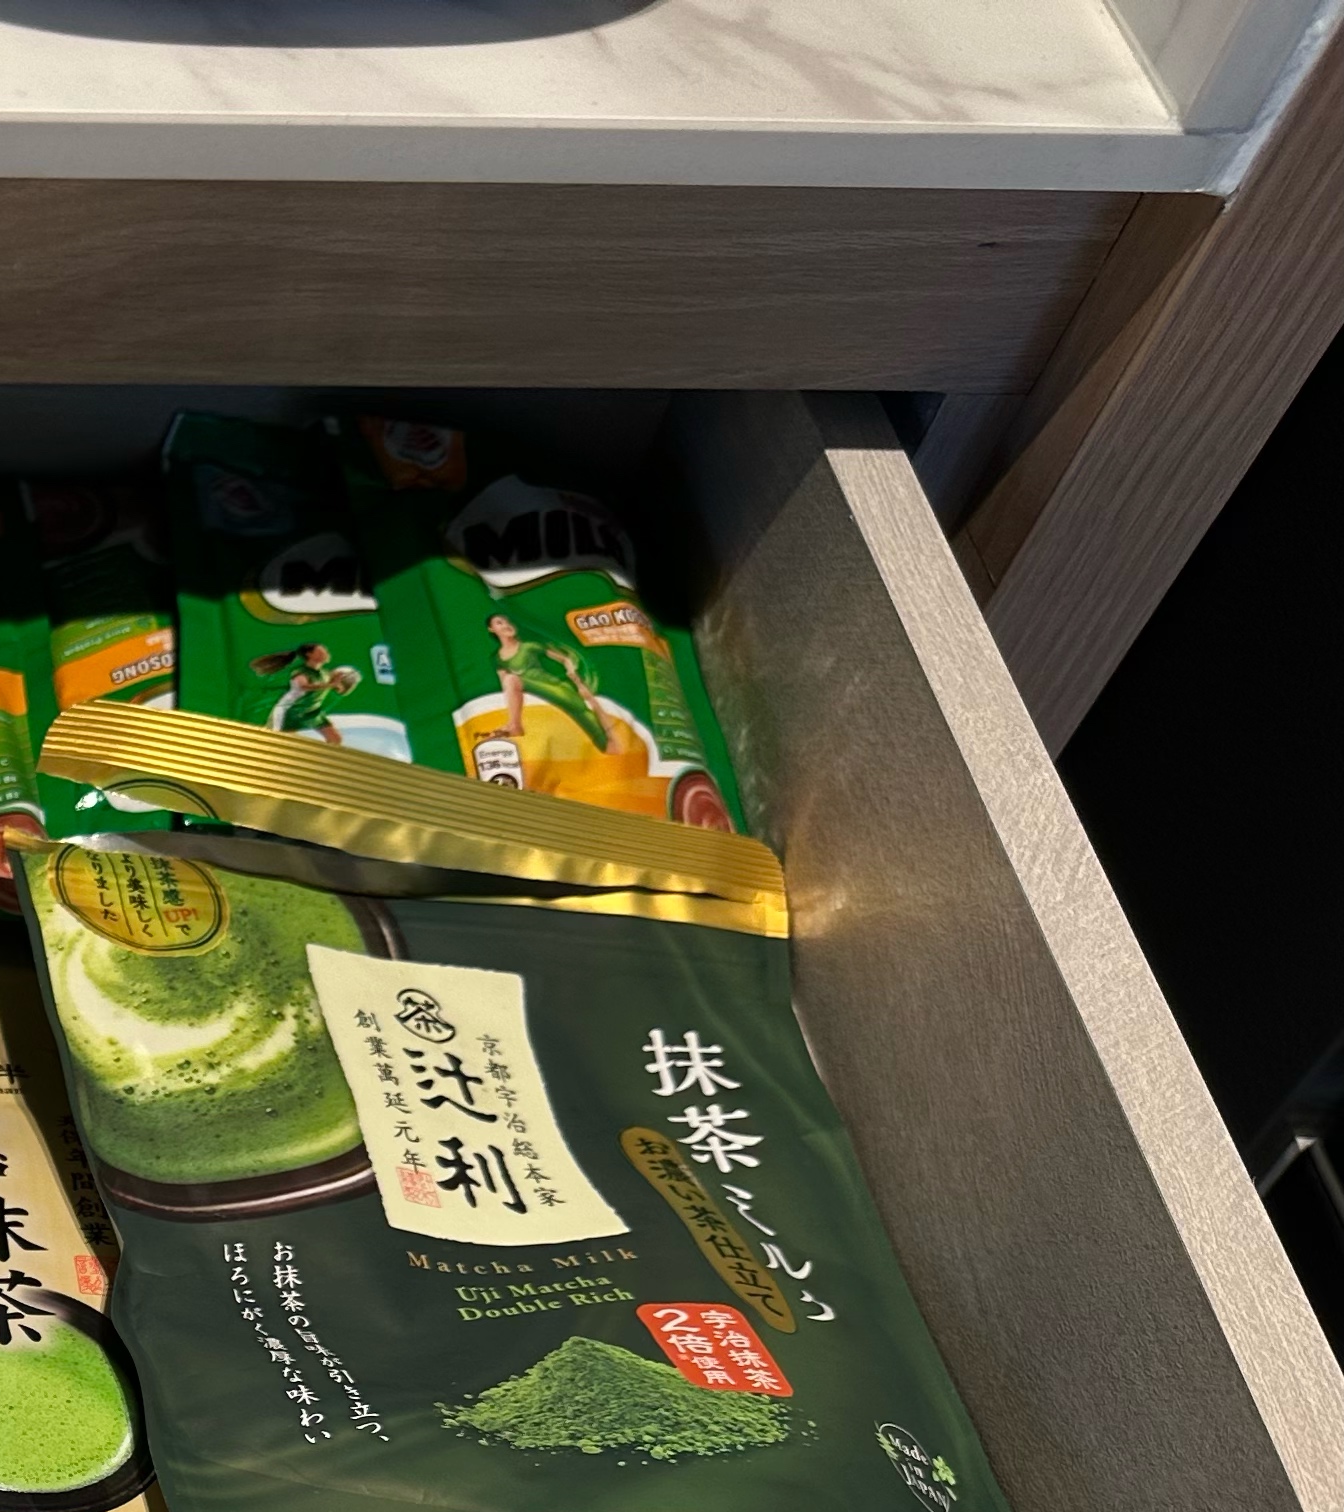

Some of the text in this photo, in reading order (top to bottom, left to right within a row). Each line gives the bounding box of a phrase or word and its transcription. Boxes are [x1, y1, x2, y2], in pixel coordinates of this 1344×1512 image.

[402, 1047, 528, 1215] 辻利
[407, 1244, 639, 1276] Matcha Milk
[454, 1273, 614, 1309] Uji Matcha
[458, 1286, 637, 1325] Double Rich
[700, 1309, 783, 1392] 宇治抹茶
